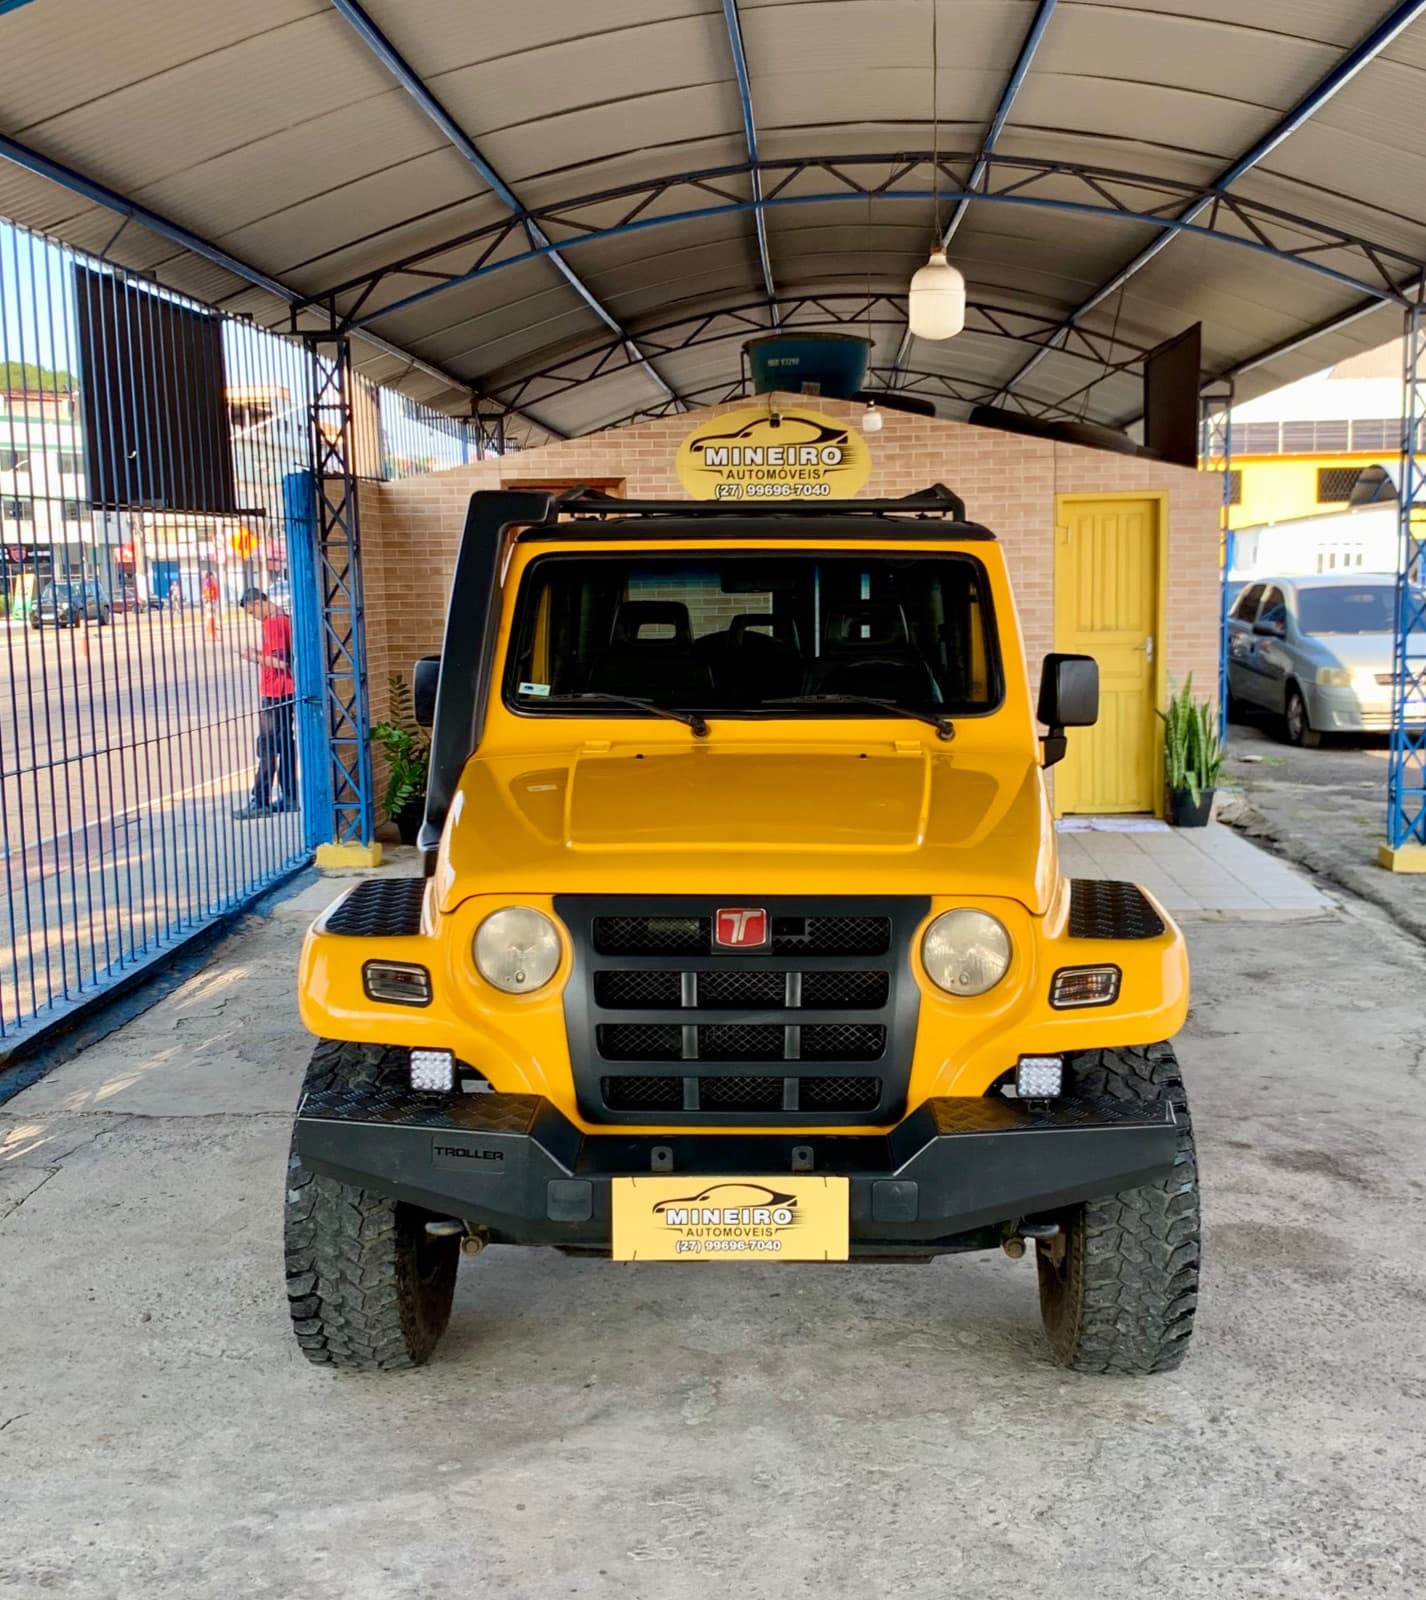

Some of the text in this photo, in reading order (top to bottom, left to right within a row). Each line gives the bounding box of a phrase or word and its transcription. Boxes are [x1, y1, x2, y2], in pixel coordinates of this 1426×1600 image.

[705, 446, 843, 466] MINEIRO
[726, 467, 821, 480] AUTOMÓVEIS
[715, 484, 830, 499] (27) 99696-7040
[434, 1146, 504, 1160] TROLLER
[666, 1208, 793, 1225] MINEIRO
[686, 1226, 774, 1237] AUTOMÓVEIS
[675, 1240, 781, 1253] (27) 99696-7040
